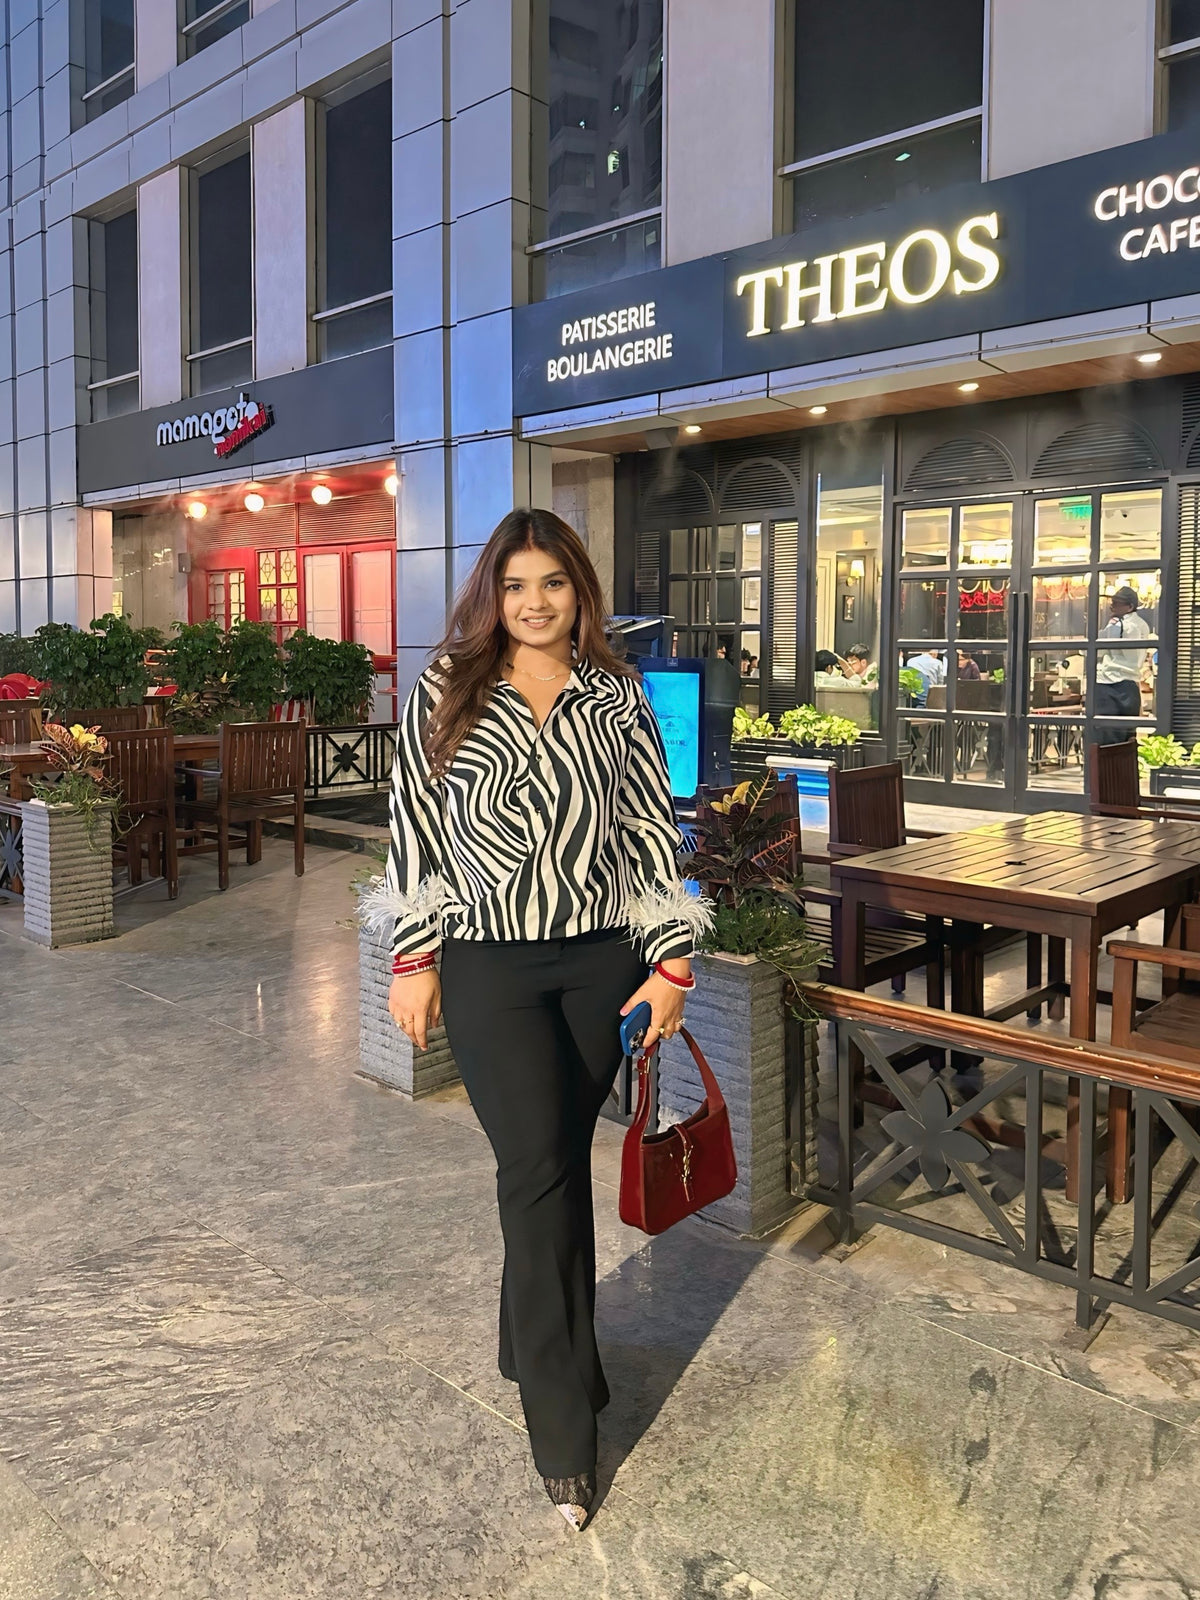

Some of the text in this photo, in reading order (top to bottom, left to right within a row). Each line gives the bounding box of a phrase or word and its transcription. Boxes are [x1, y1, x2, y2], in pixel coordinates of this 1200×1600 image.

[1094, 166, 1200, 221] CHOC
[736, 211, 1000, 337] THEOS
[561, 301, 656, 346] PATISSERIE
[547, 333, 673, 382] BOULANGERIE
[156, 392, 260, 446] mamagoto
